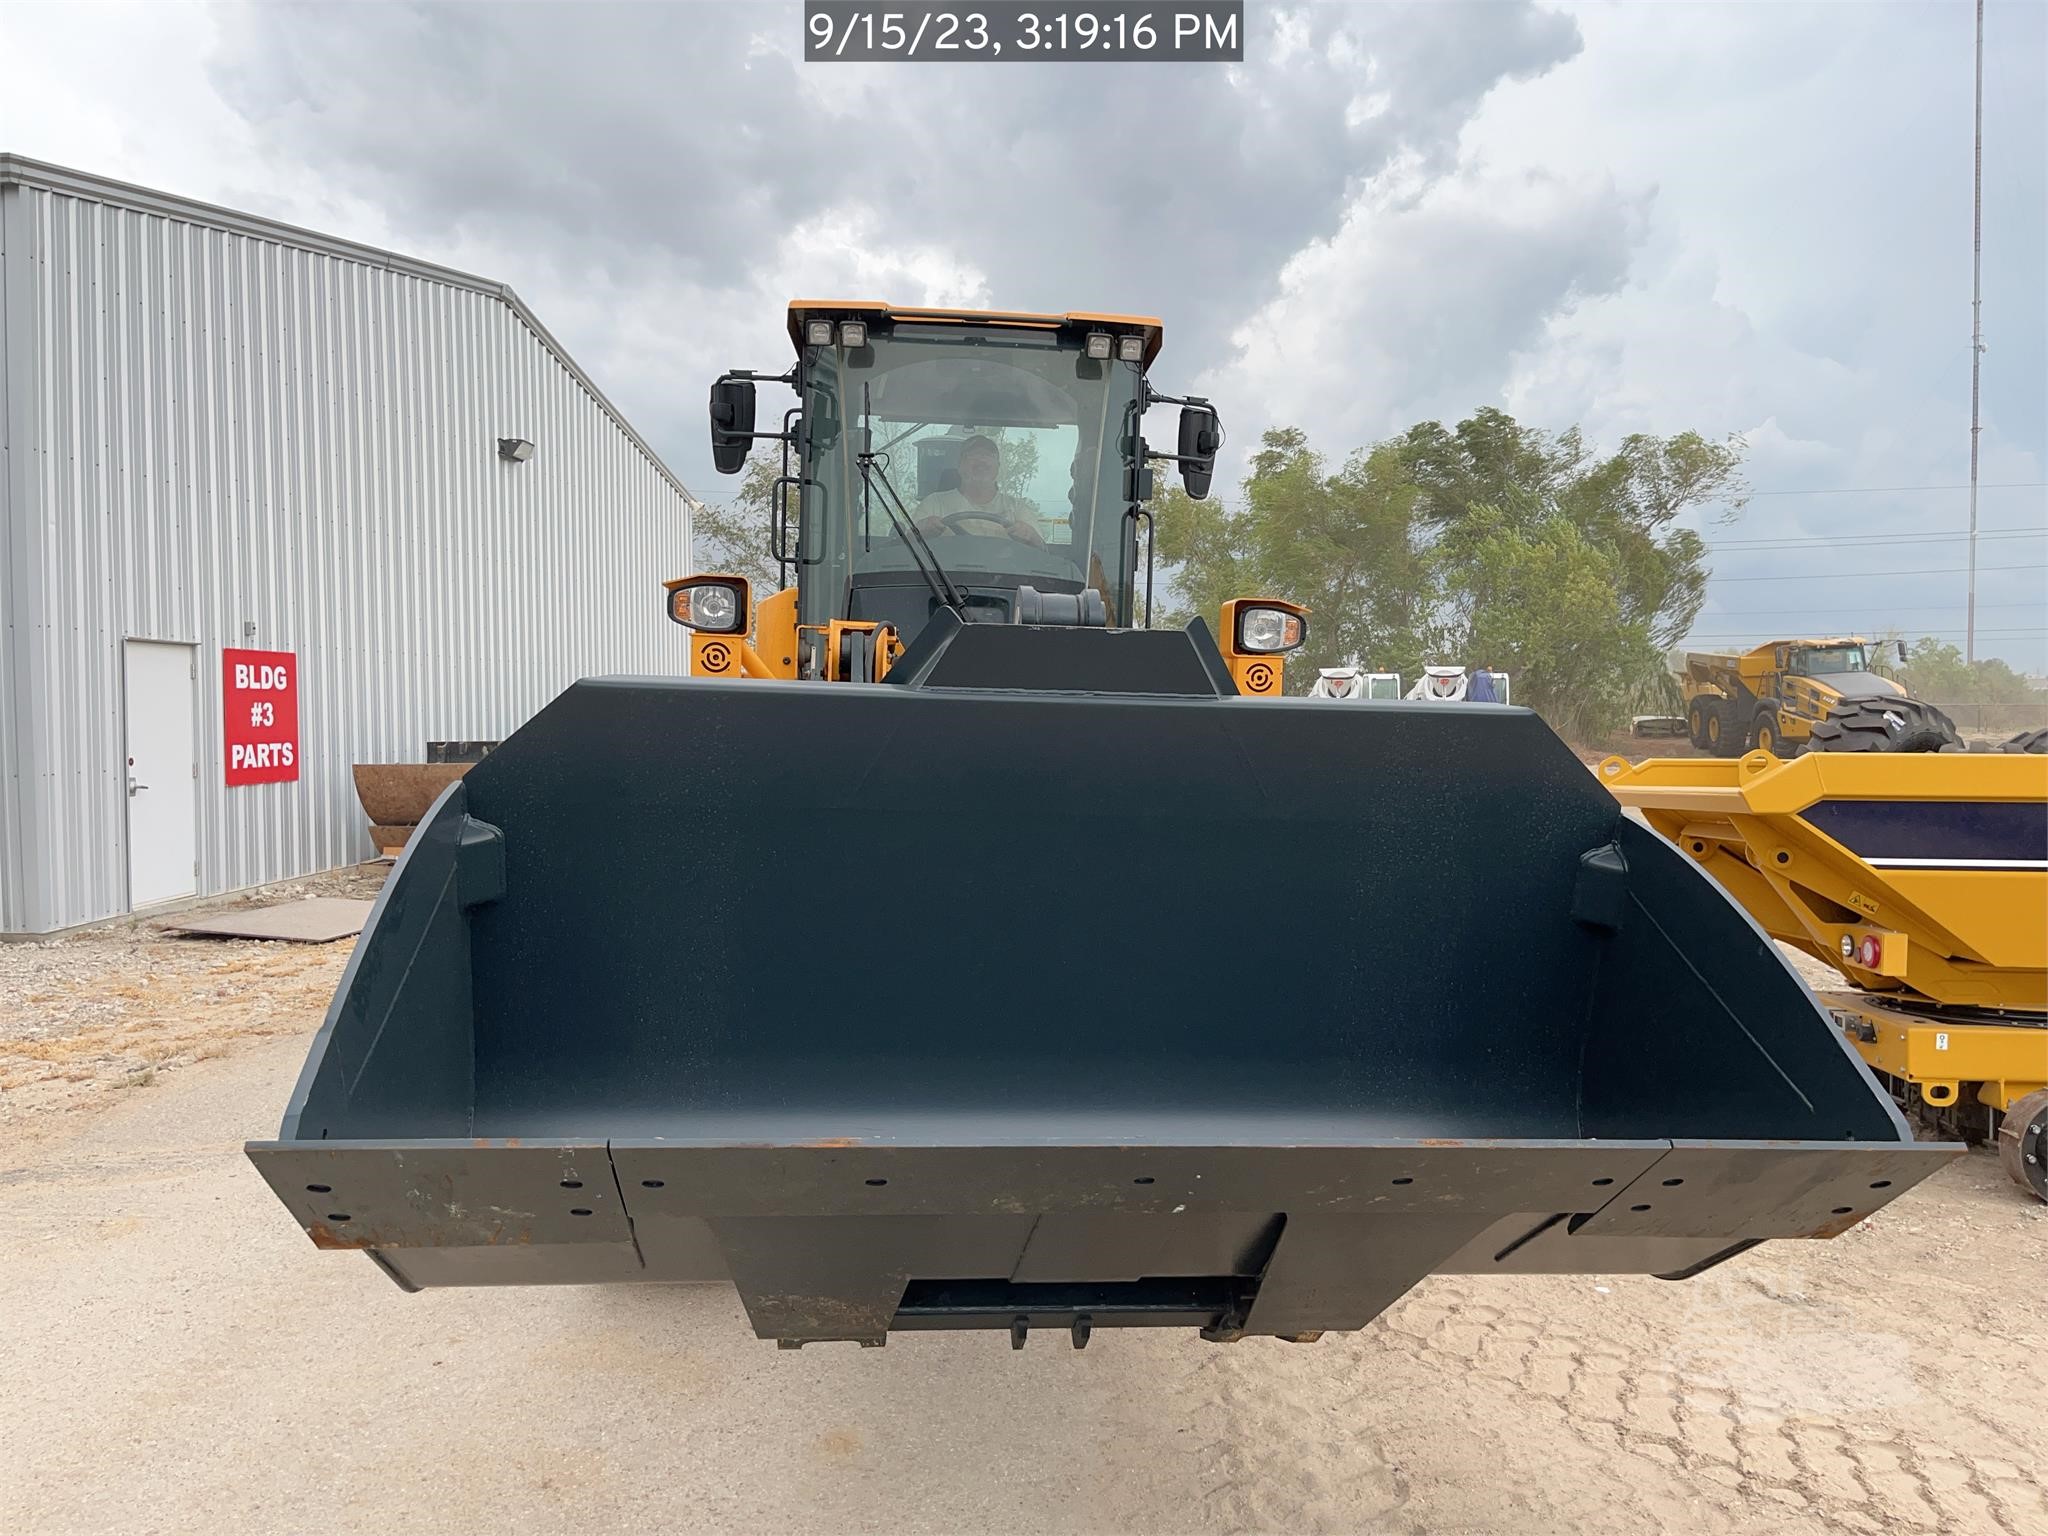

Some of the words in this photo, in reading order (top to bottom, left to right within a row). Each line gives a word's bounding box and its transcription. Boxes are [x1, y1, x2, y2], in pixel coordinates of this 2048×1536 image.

[235, 664, 287, 690] BLDG
[250, 702, 274, 727] #3
[231, 742, 294, 769] PARTS
